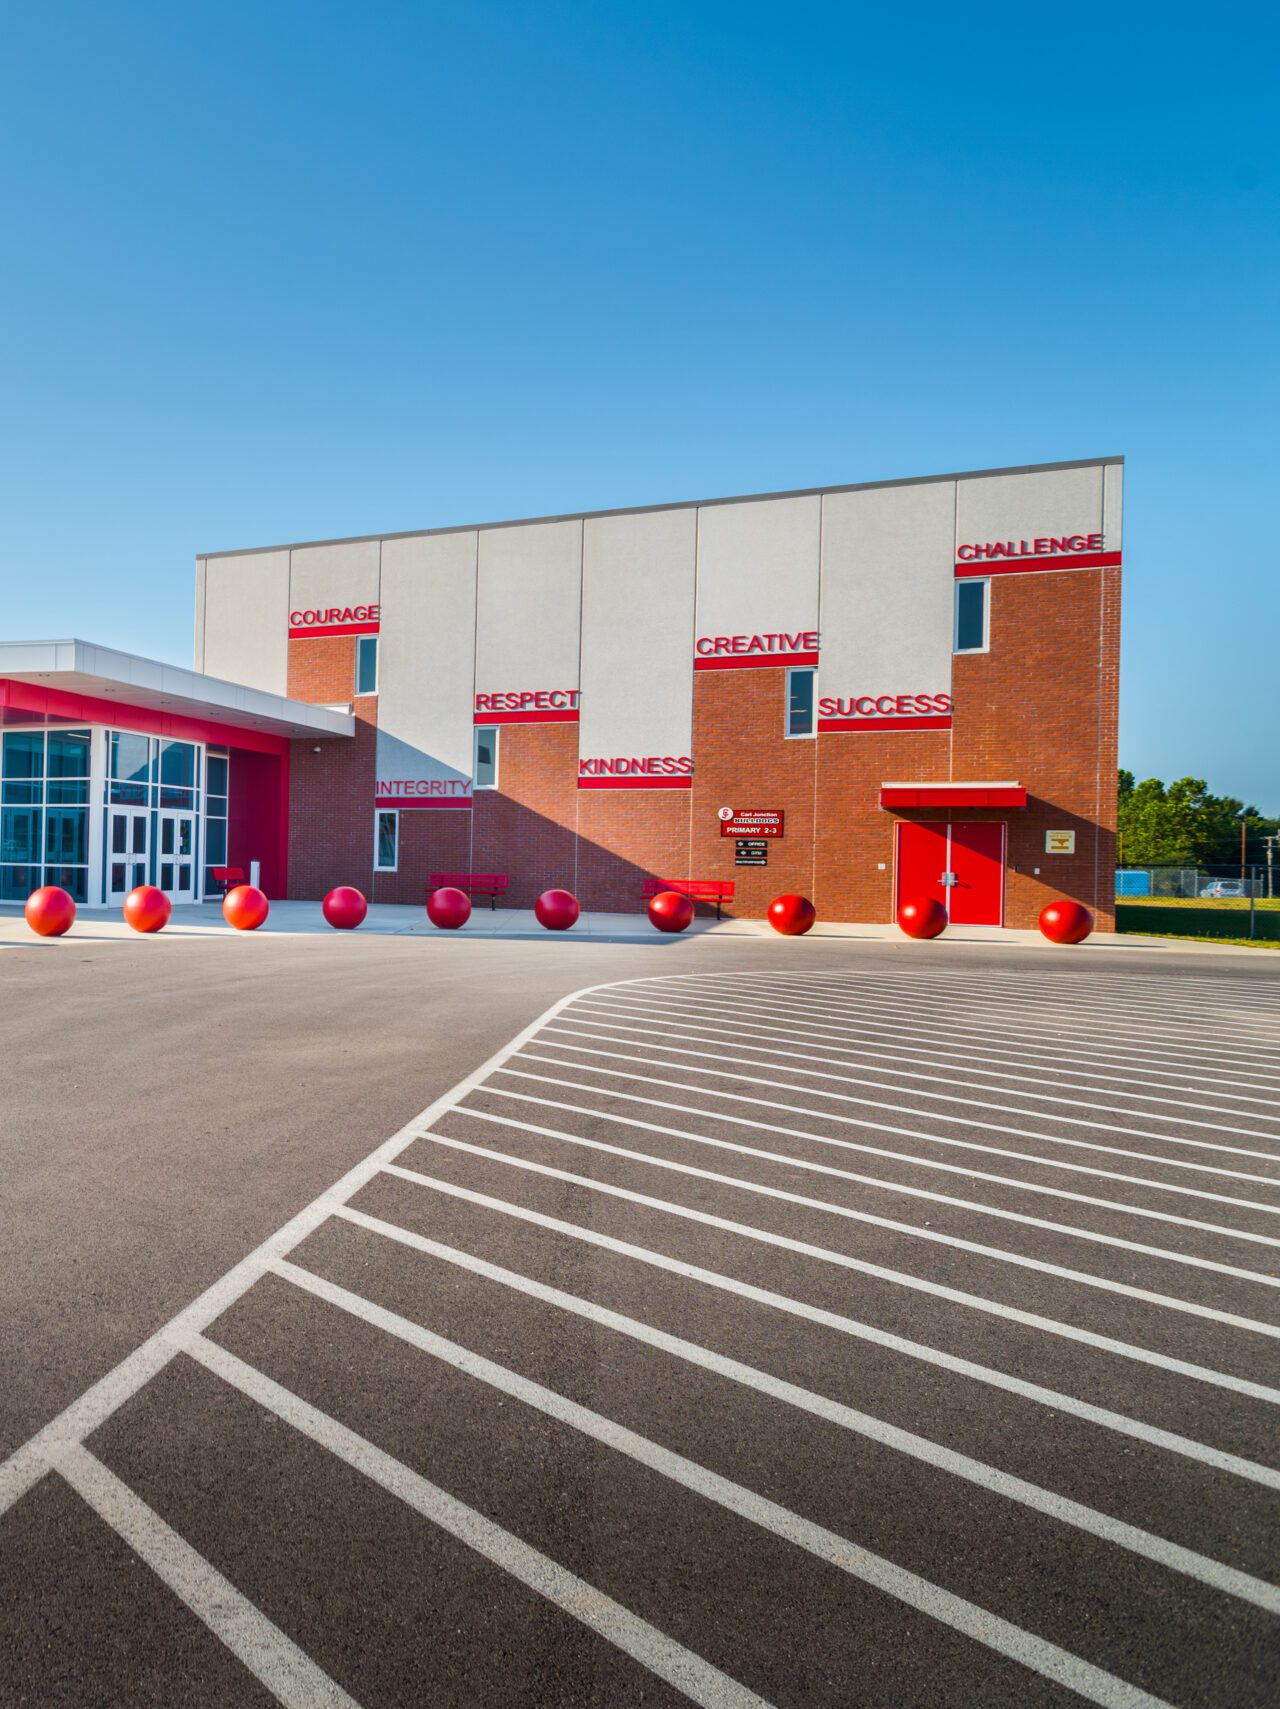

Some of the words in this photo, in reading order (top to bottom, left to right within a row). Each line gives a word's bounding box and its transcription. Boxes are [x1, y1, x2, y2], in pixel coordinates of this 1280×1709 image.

[957, 533, 1104, 560] CHALLENGE
[290, 604, 380, 626] COURAGE
[696, 631, 819, 655] CREATIVE
[475, 689, 580, 711] RESPECT
[818, 693, 952, 717] SUCCESS
[579, 756, 692, 775] KINDNESS
[376, 780, 473, 795] INTEGRITY
